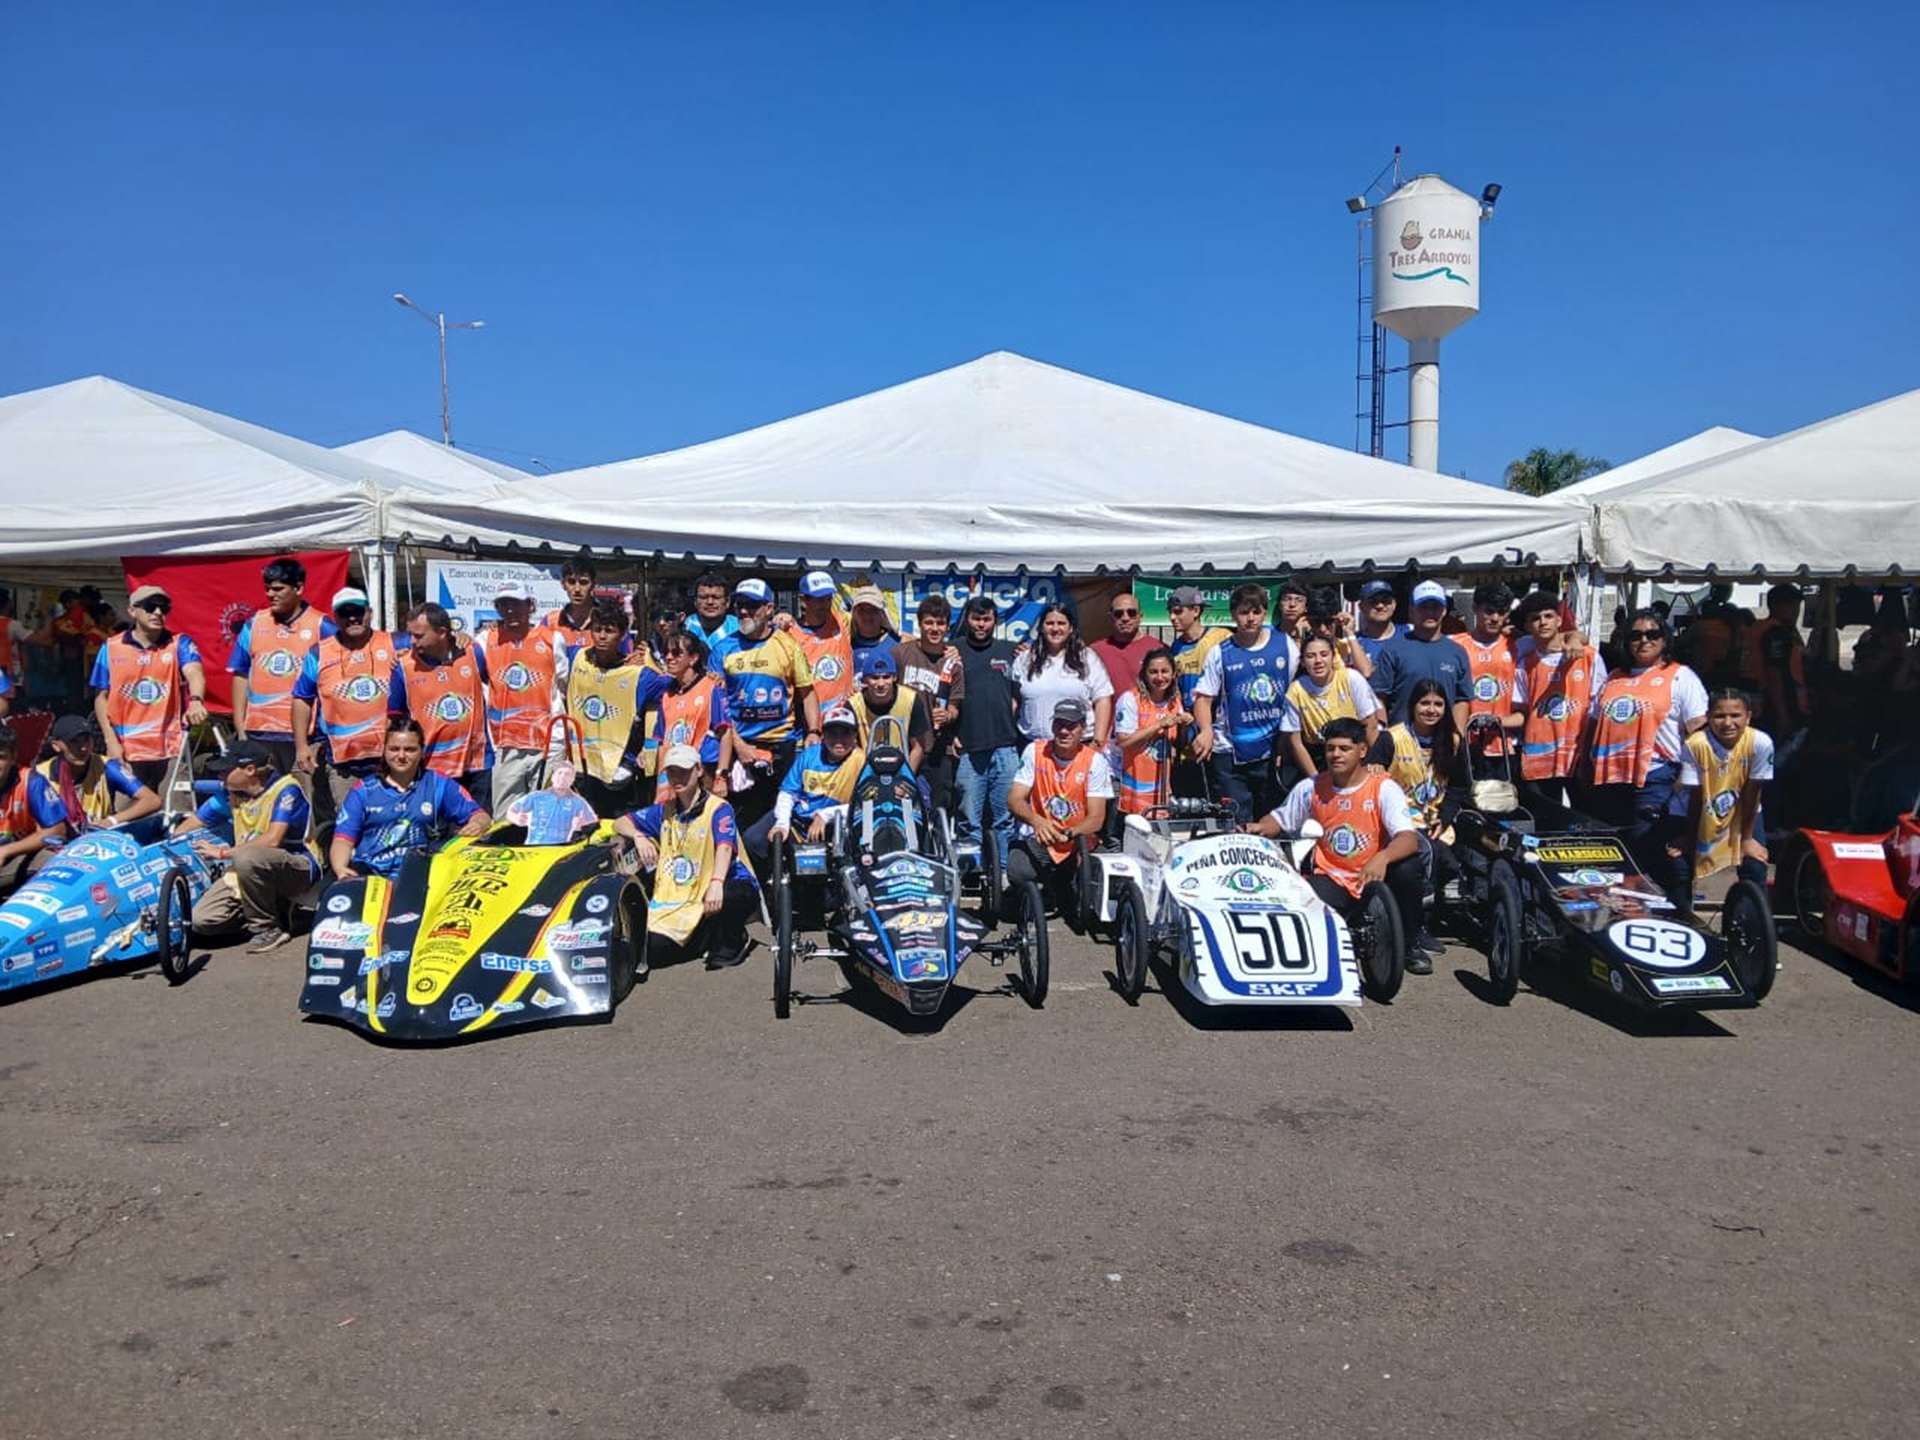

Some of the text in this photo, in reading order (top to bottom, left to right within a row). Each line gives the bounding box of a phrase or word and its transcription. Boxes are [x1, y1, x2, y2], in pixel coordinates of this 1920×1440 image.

[1429, 228, 1471, 241] GRANJA
[1388, 251, 1415, 268] TRES
[448, 568, 490, 579] Escuela
[491, 570, 504, 580] de
[1186, 854, 1218, 873] PEÑA
[1228, 911, 1310, 969] 50
[1625, 924, 1691, 960] 63
[484, 953, 552, 971] Enersa
[1249, 983, 1318, 995] SKF
